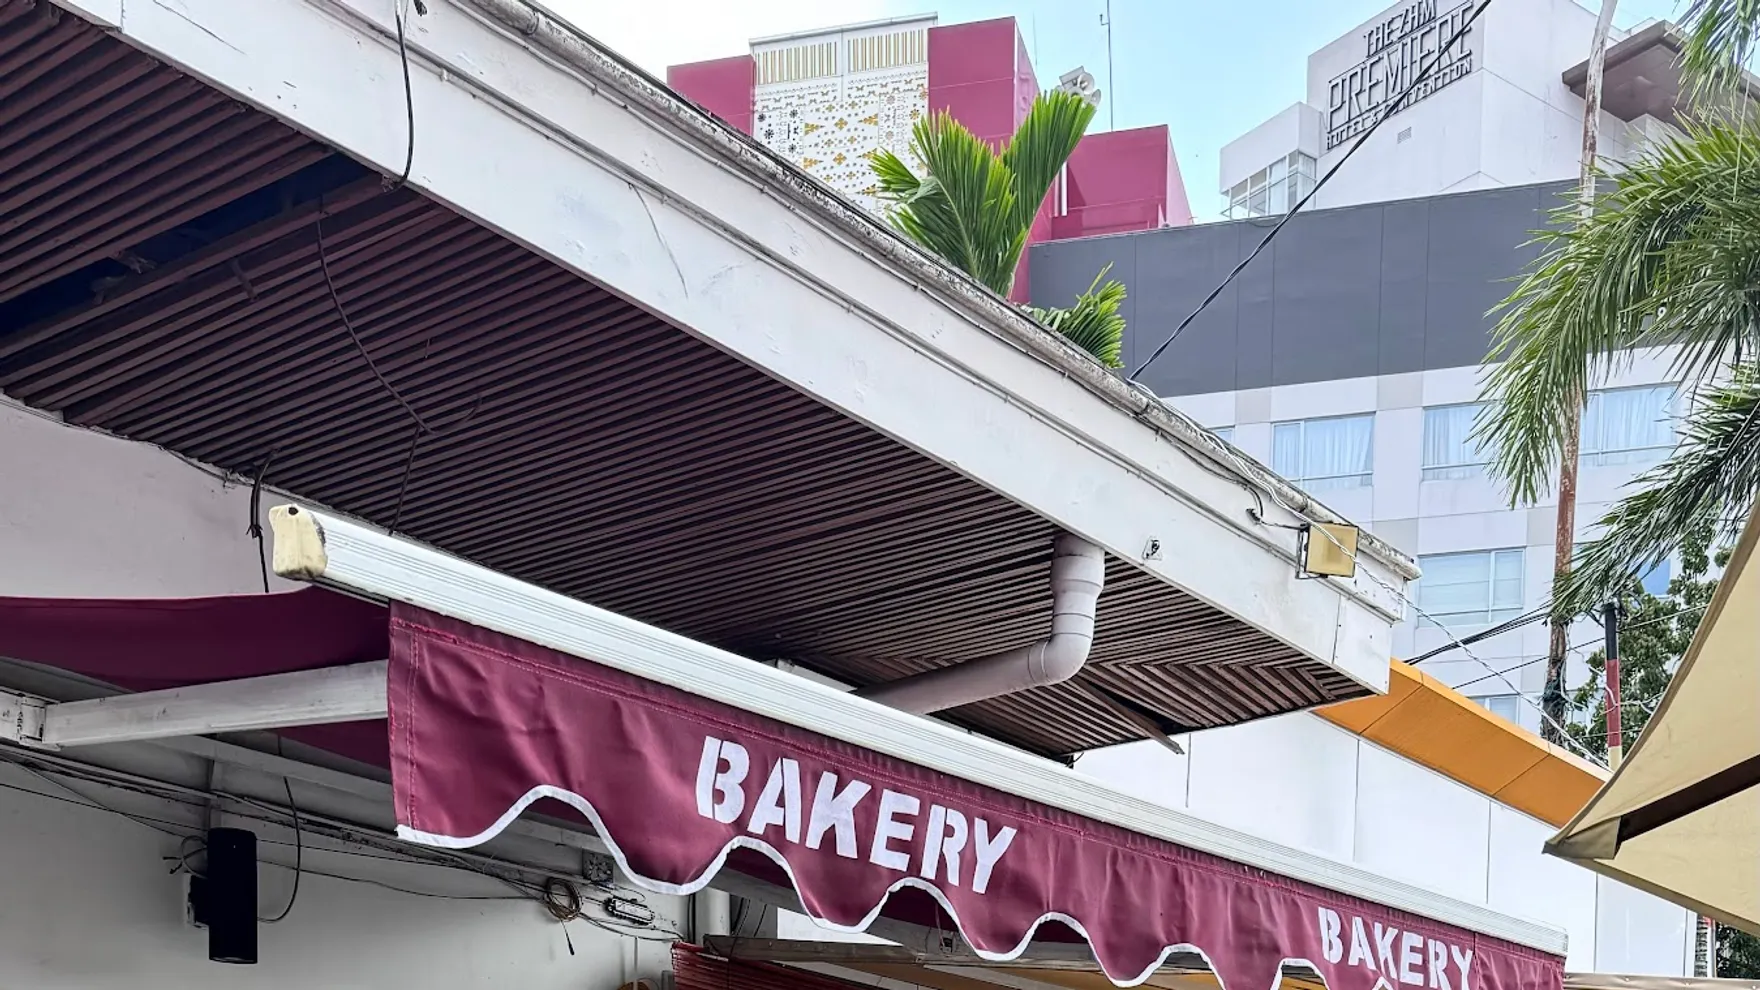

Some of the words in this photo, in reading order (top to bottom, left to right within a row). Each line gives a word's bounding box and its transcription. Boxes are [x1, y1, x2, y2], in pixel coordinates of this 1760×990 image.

[1327, 2, 1474, 134] PREMIERE
[1364, 13, 1403, 58] THE
[1397, 0, 1438, 40] ZHM
[1326, 117, 1371, 151] HOTEL
[695, 736, 1017, 894] BAKERY
[1318, 906, 1474, 990] BAKERY
